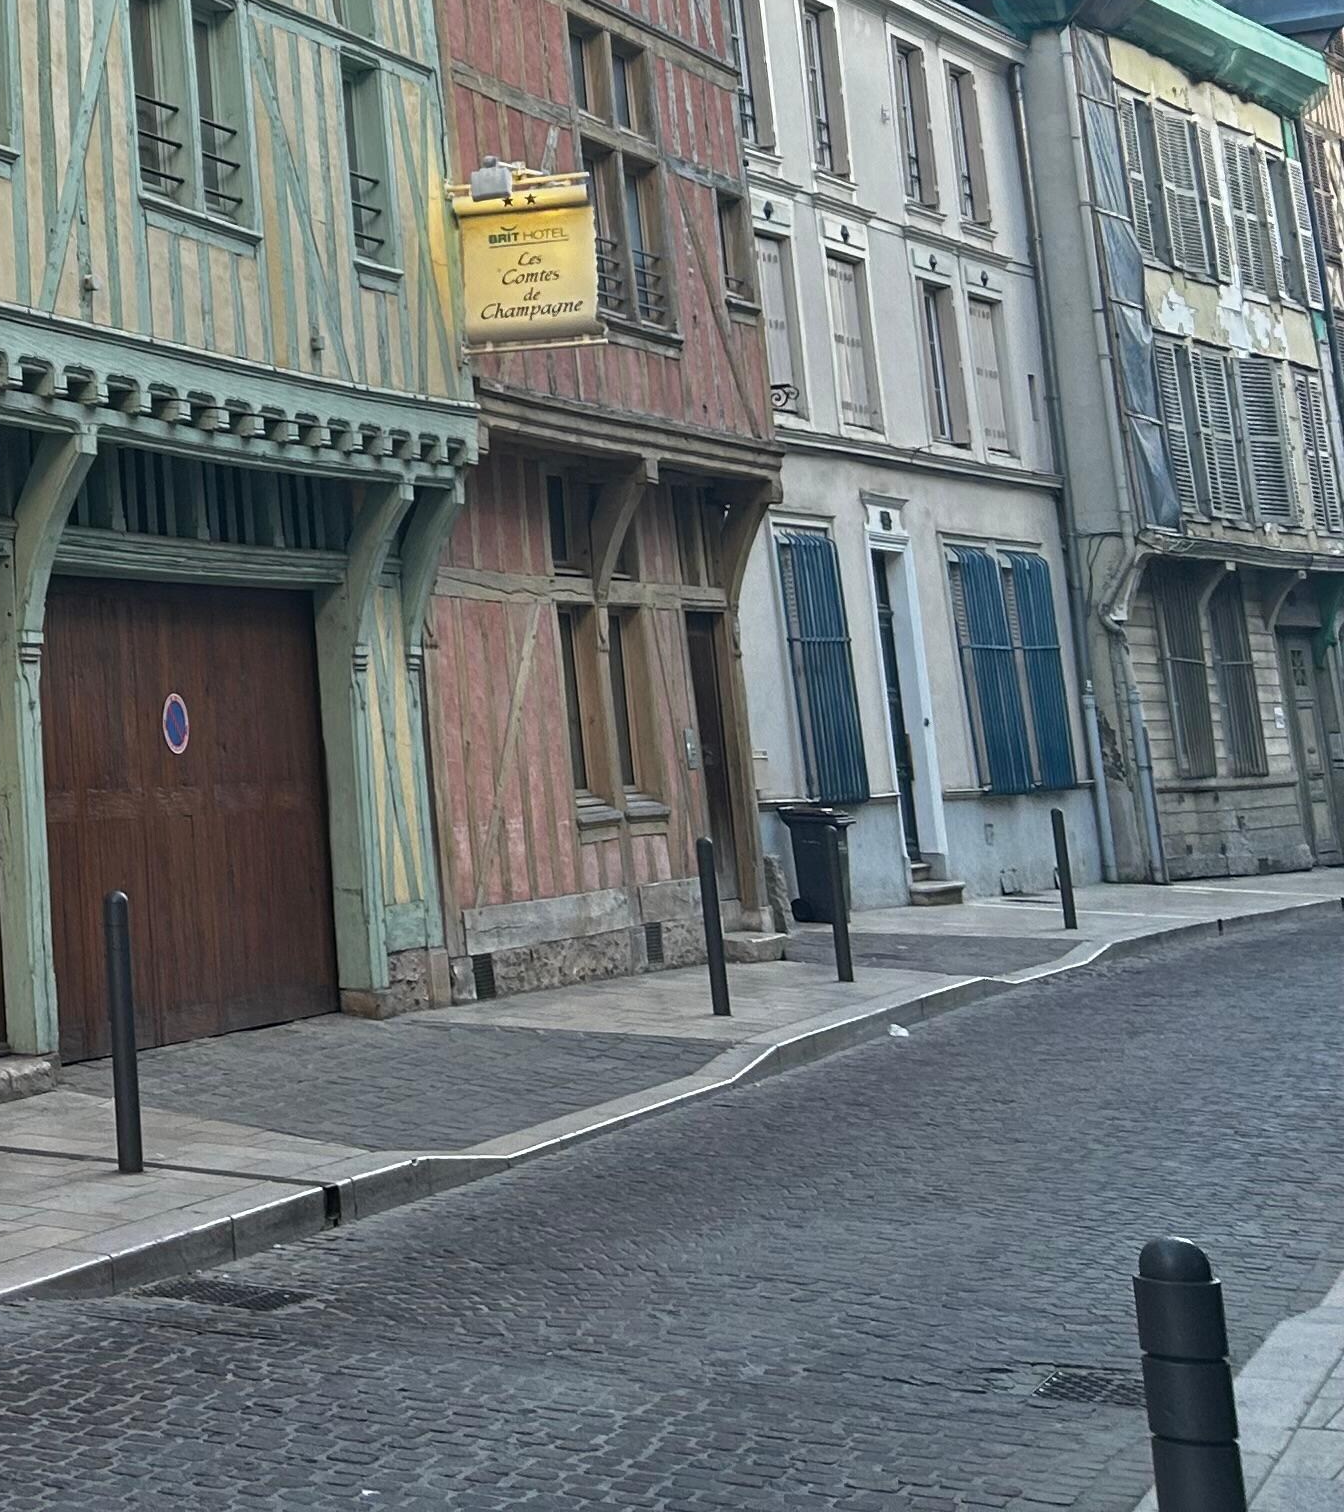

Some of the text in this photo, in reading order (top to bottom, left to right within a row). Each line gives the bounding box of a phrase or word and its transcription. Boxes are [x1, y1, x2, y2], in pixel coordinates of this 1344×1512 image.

[523, 228, 568, 240] HOTEL
[517, 252, 542, 266] Les
[501, 269, 560, 285] Comtes
[523, 287, 541, 301] de
[480, 300, 584, 321] Champagne
